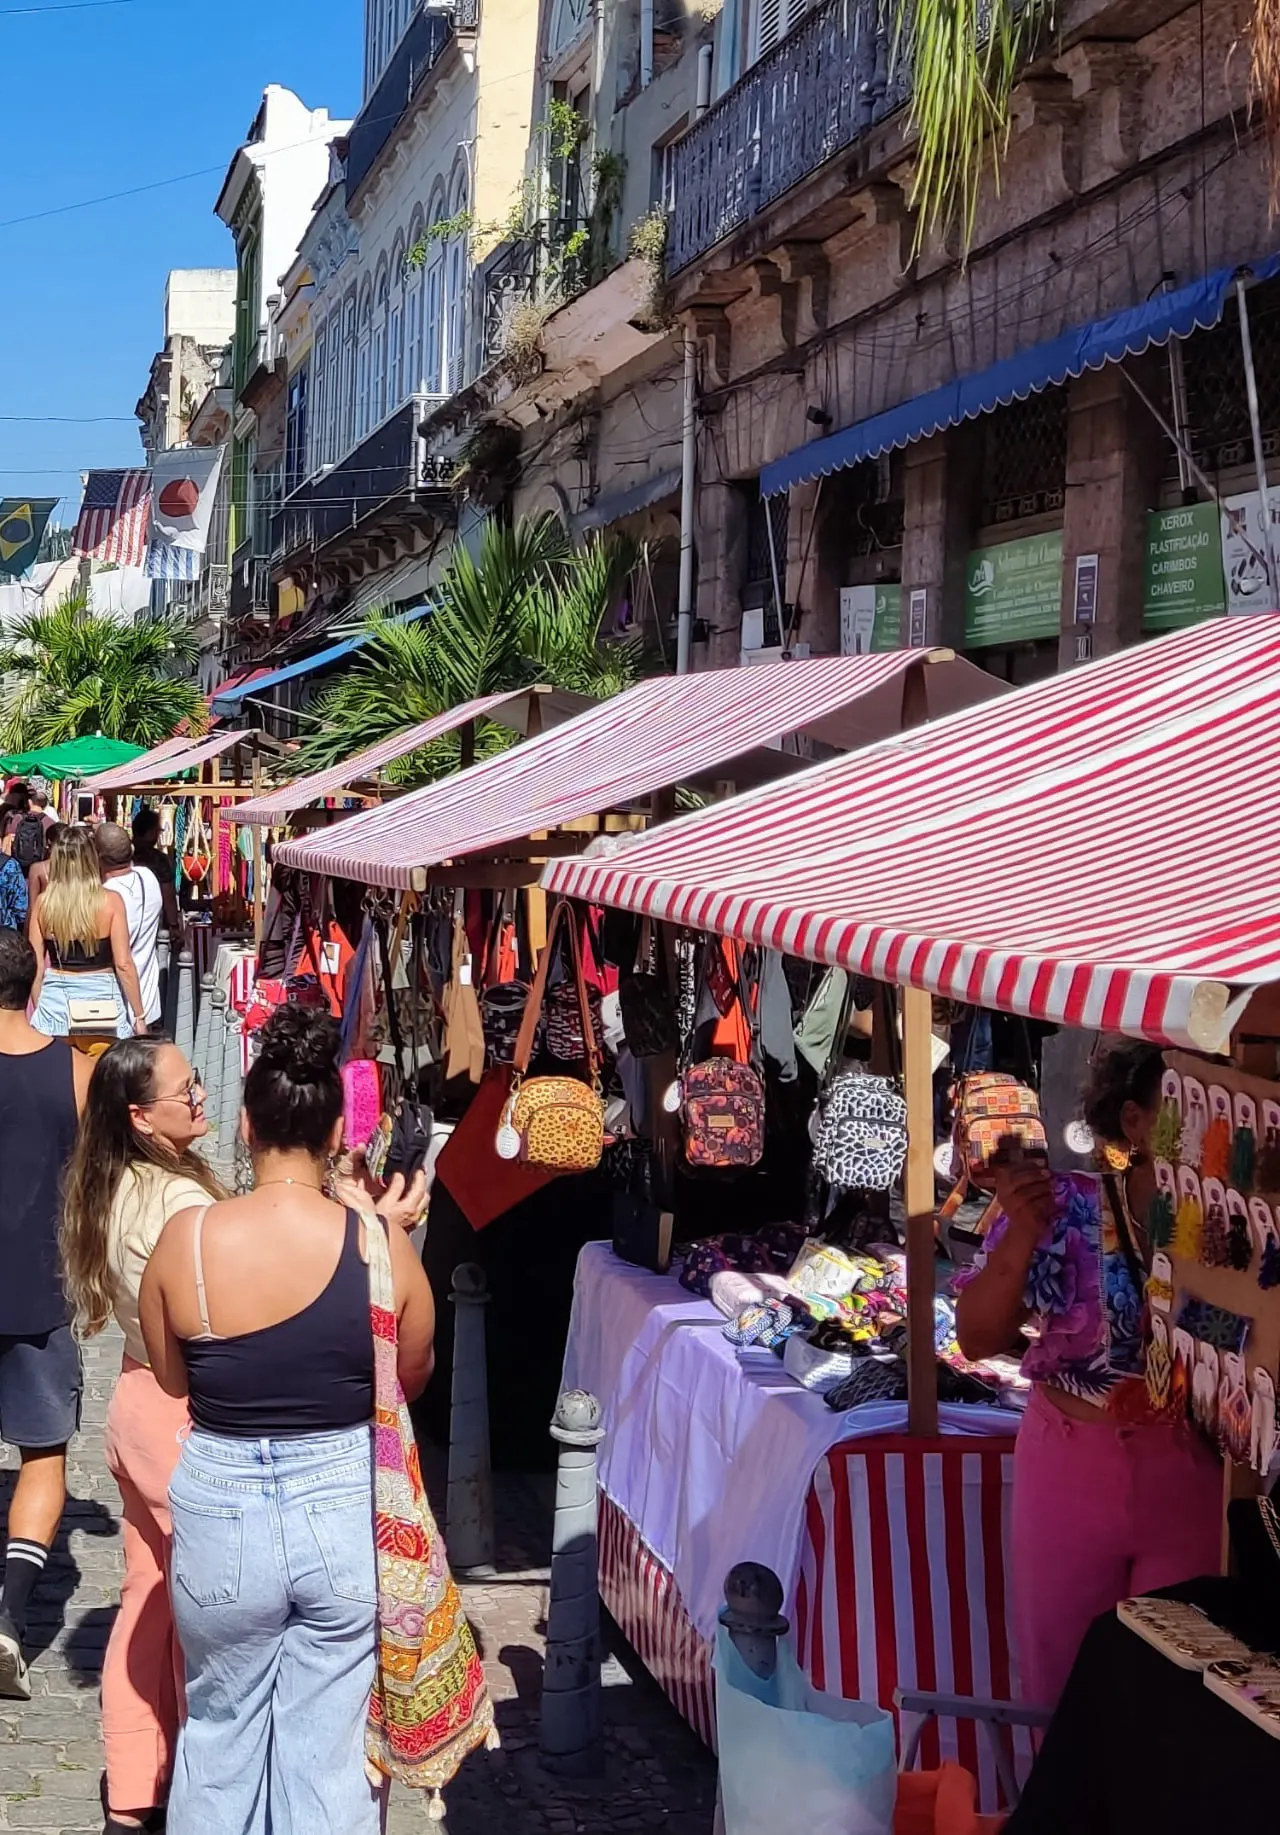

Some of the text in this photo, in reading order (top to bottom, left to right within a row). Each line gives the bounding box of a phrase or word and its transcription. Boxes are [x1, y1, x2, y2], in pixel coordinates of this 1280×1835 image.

[1160, 512, 1194, 531] XEROX
[1150, 532, 1210, 555] PLASTIFICAÇÃO
[1152, 557, 1197, 575] CARIMBOS
[1151, 579, 1195, 596] CHAVEIRO
